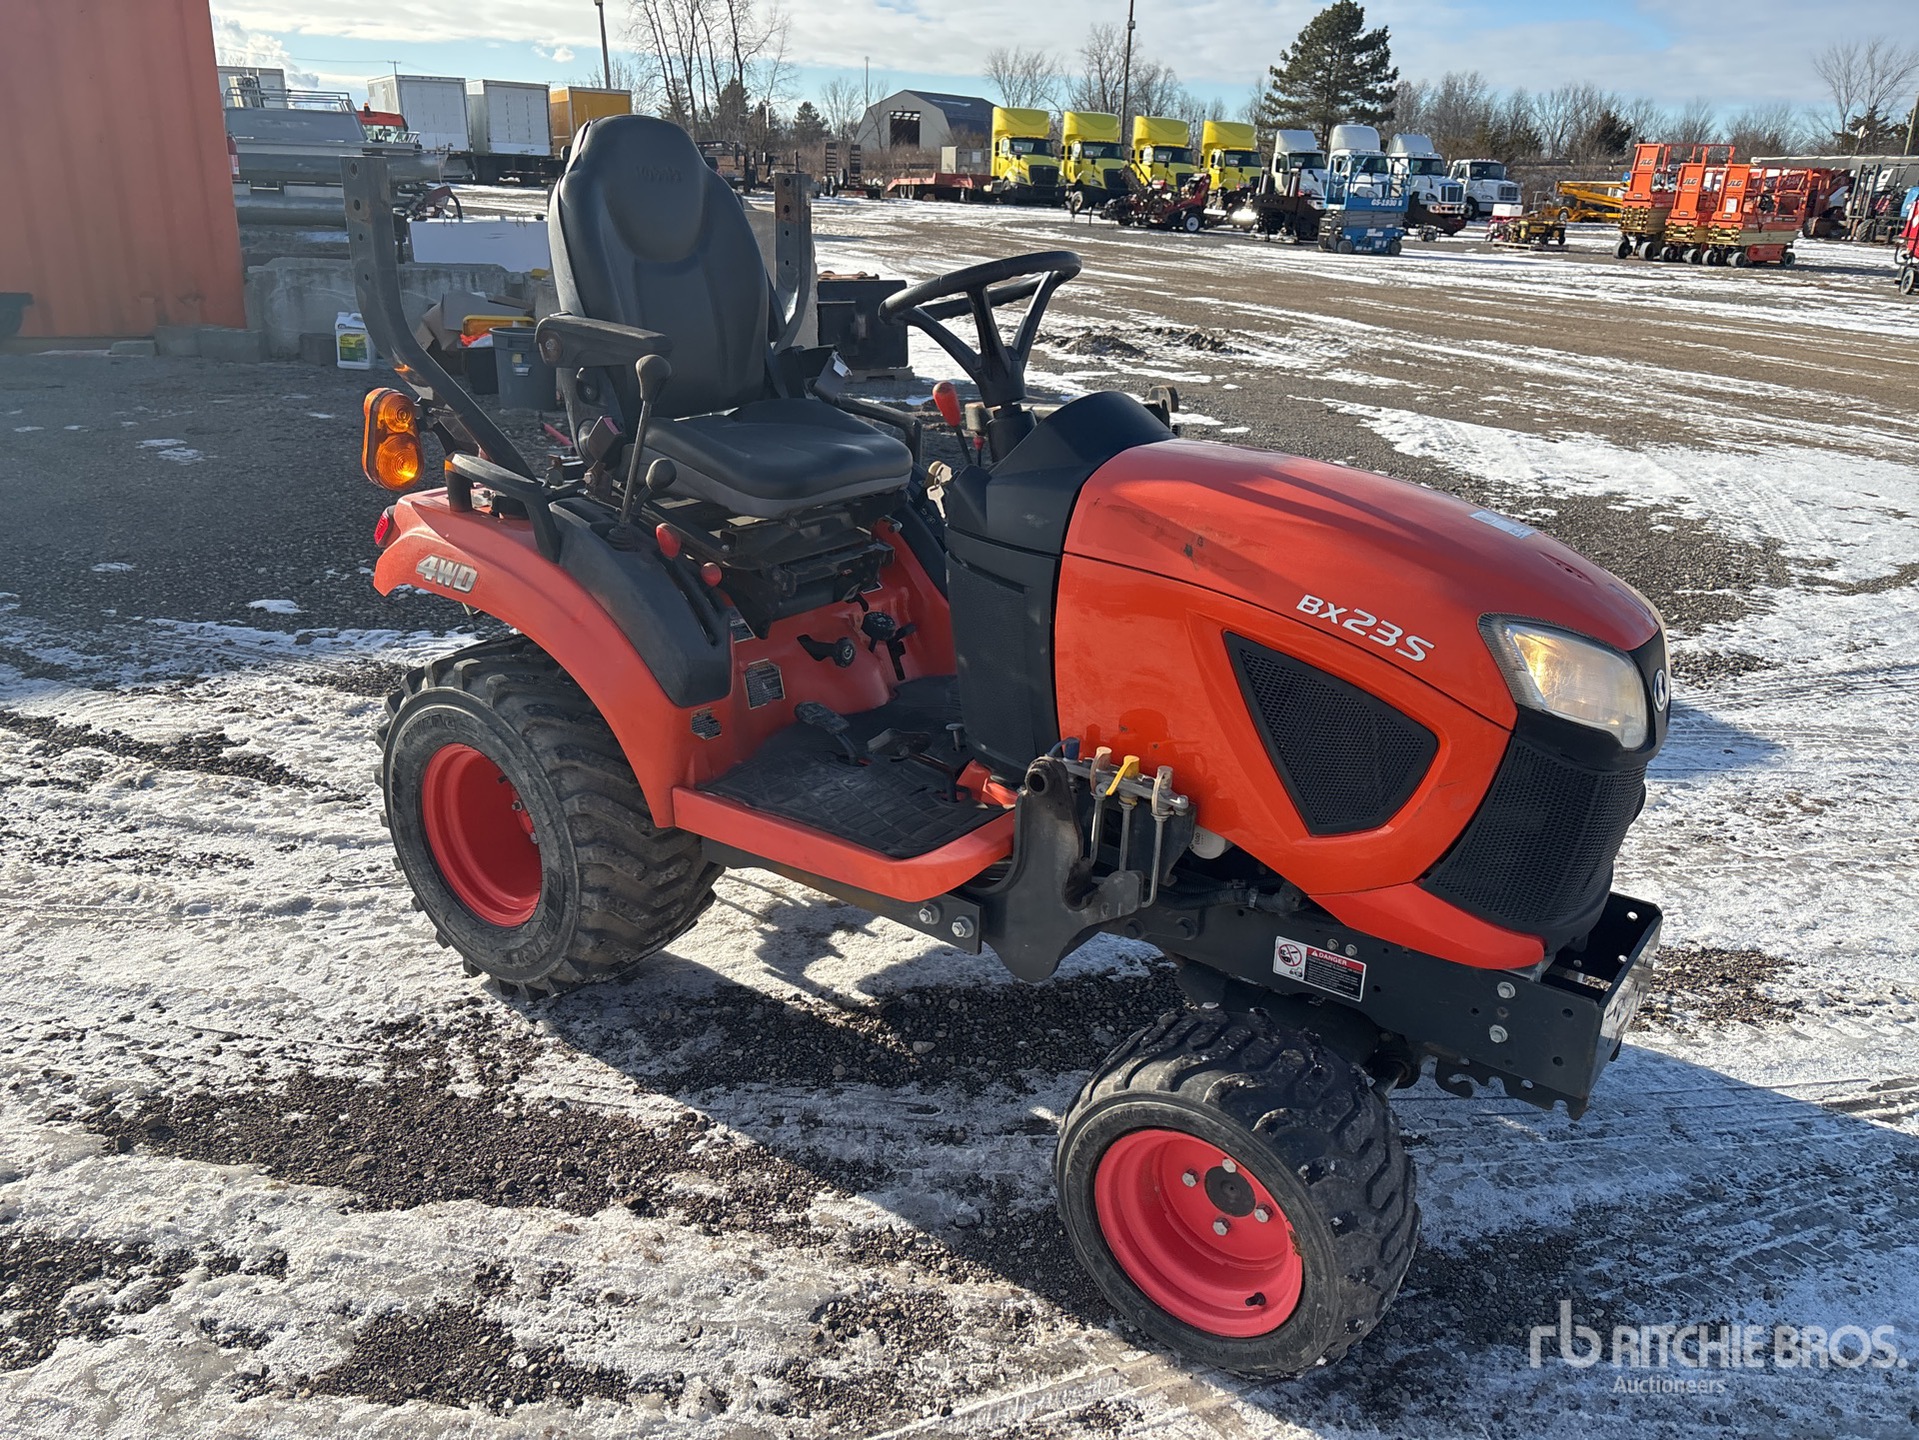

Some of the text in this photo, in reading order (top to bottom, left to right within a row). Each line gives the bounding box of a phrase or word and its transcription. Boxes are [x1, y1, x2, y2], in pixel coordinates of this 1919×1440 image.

[416, 554, 478, 594] 4WD
[1296, 594, 1435, 662] BX23S
[1318, 952, 1348, 966] DANGER
